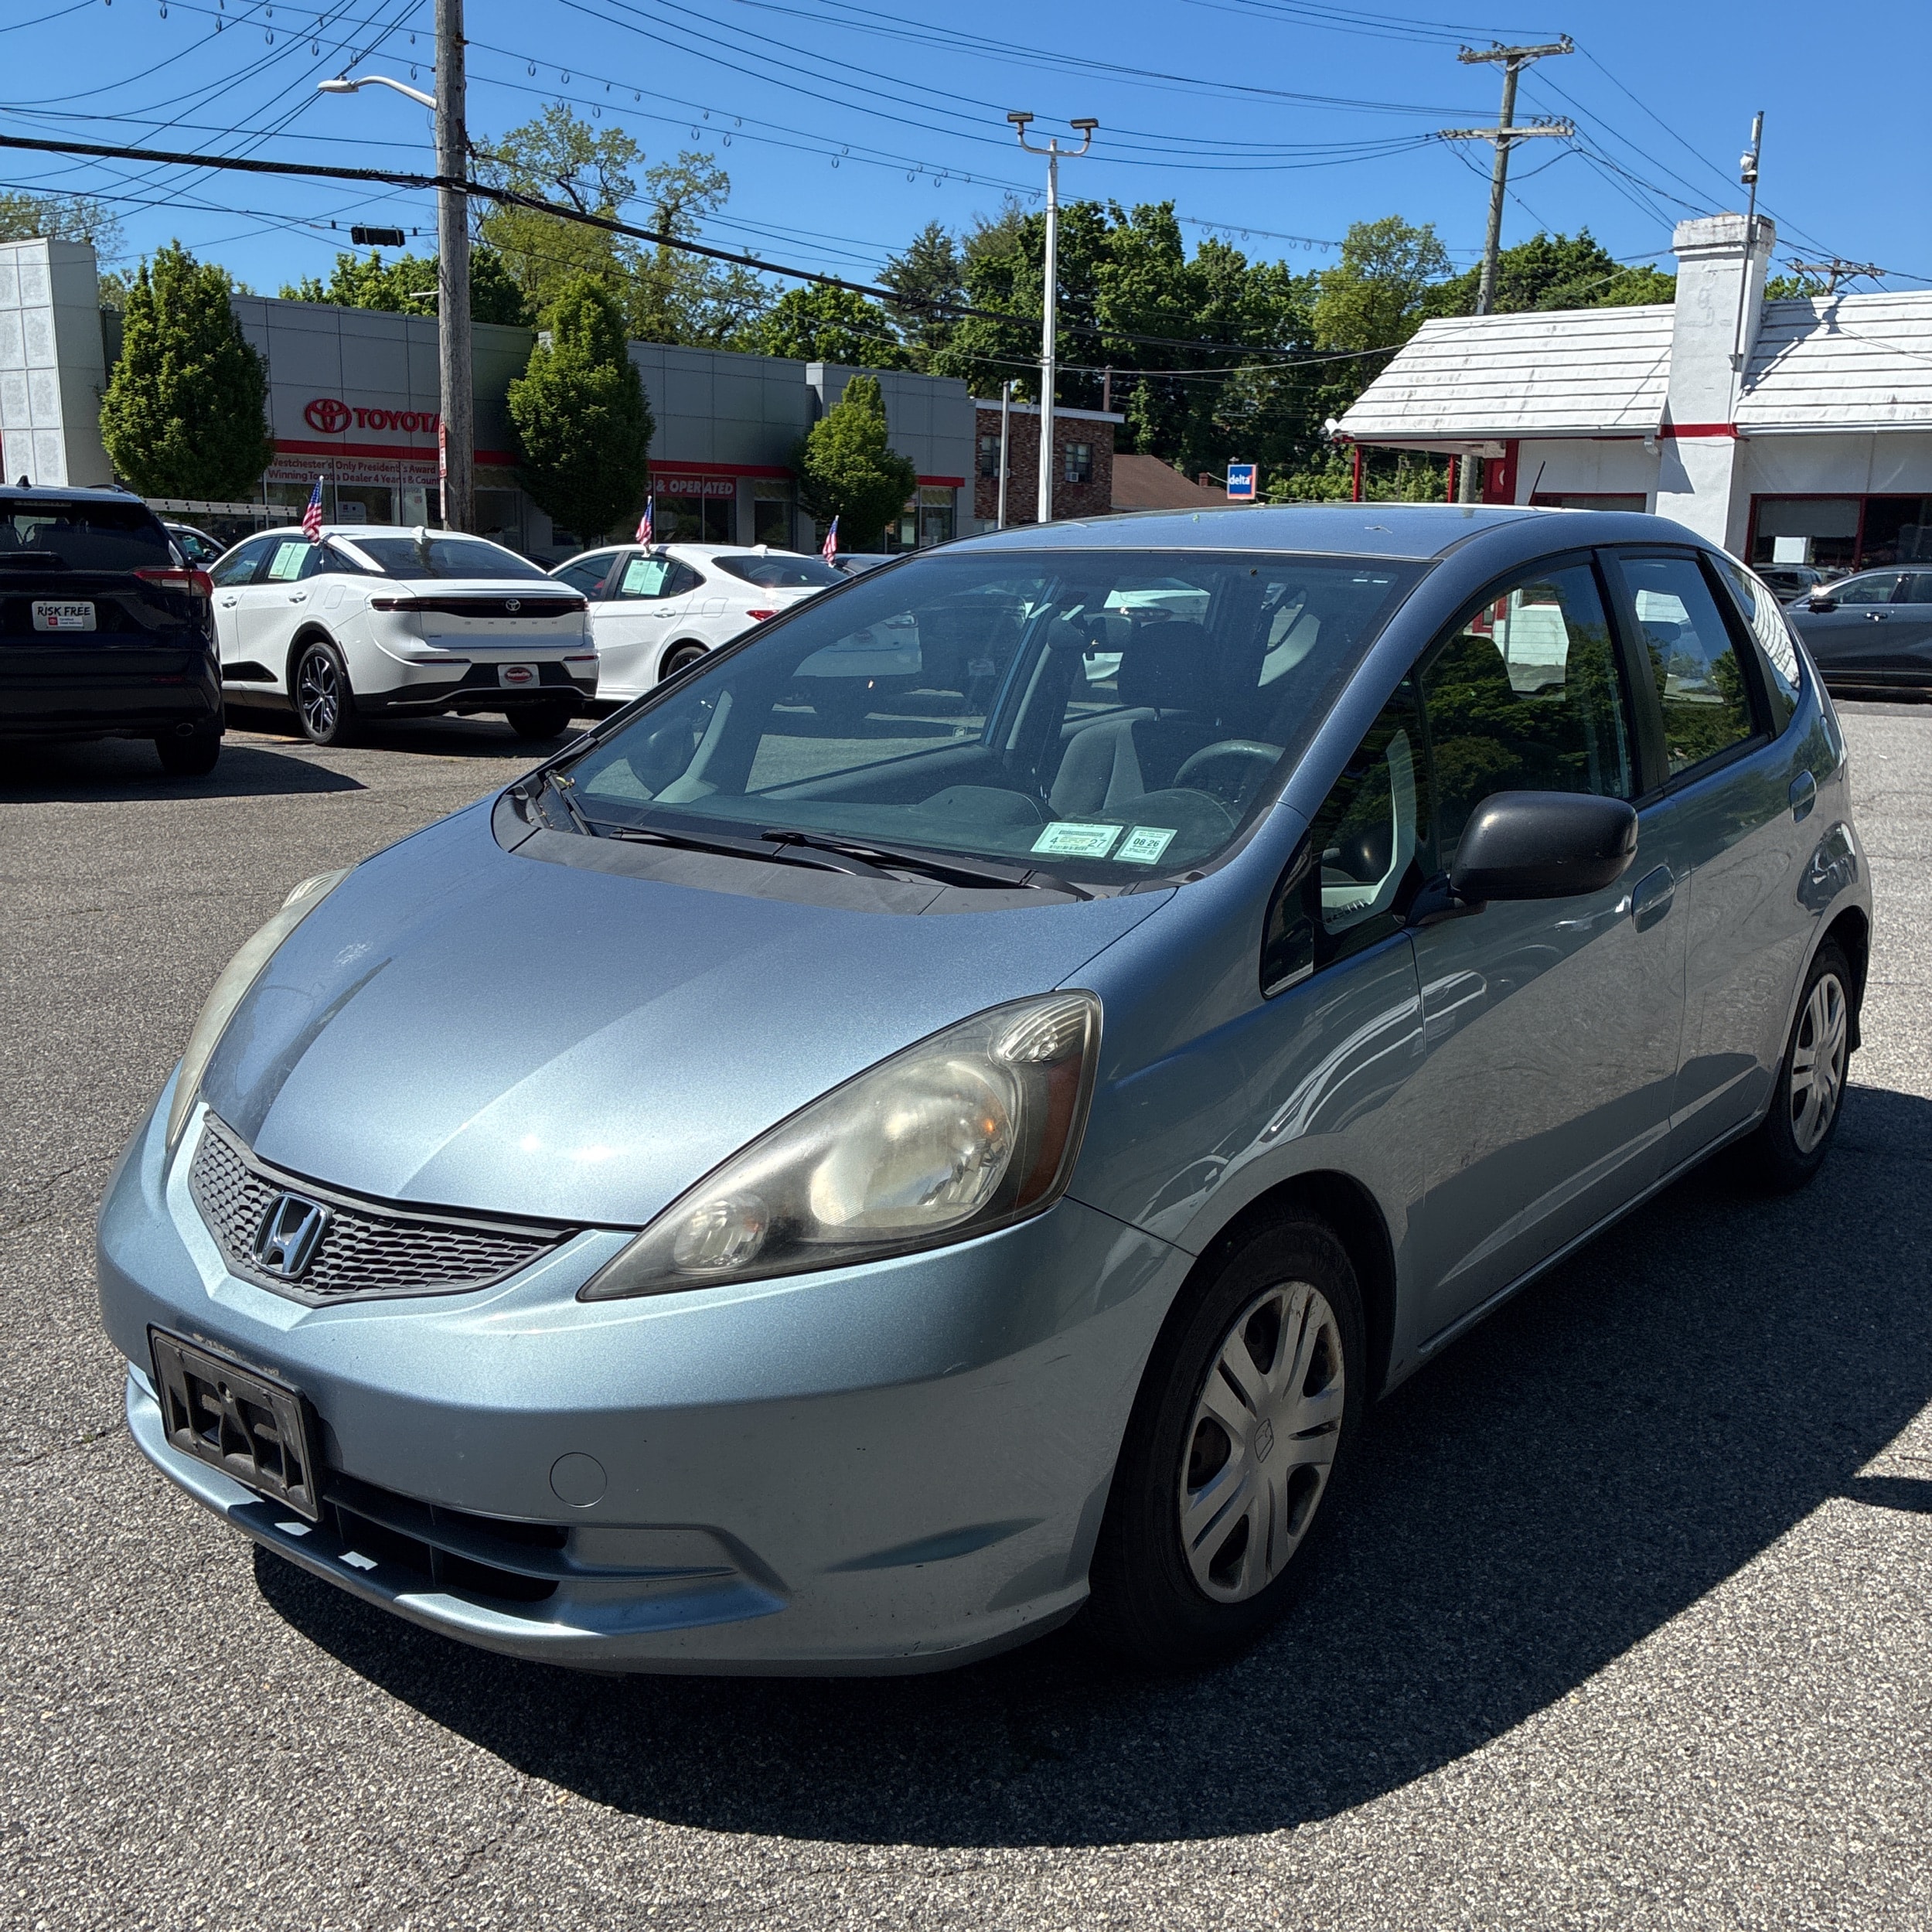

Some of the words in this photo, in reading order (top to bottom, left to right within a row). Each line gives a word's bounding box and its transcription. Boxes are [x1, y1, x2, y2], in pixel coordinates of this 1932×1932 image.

[336, 461, 356, 472] Only
[409, 465, 436, 474] Award
[268, 469, 307, 482] Winning
[308, 472, 340, 481] Toota
[342, 473, 372, 482] Dealer
[407, 475, 414, 484] &
[1229, 474, 1250, 485] delta
[656, 479, 665, 492] &
[670, 480, 734, 495] OPERATED
[37, 606, 62, 616] RISK
[64, 606, 90, 616] FREE
[1089, 839, 1107, 847] 27
